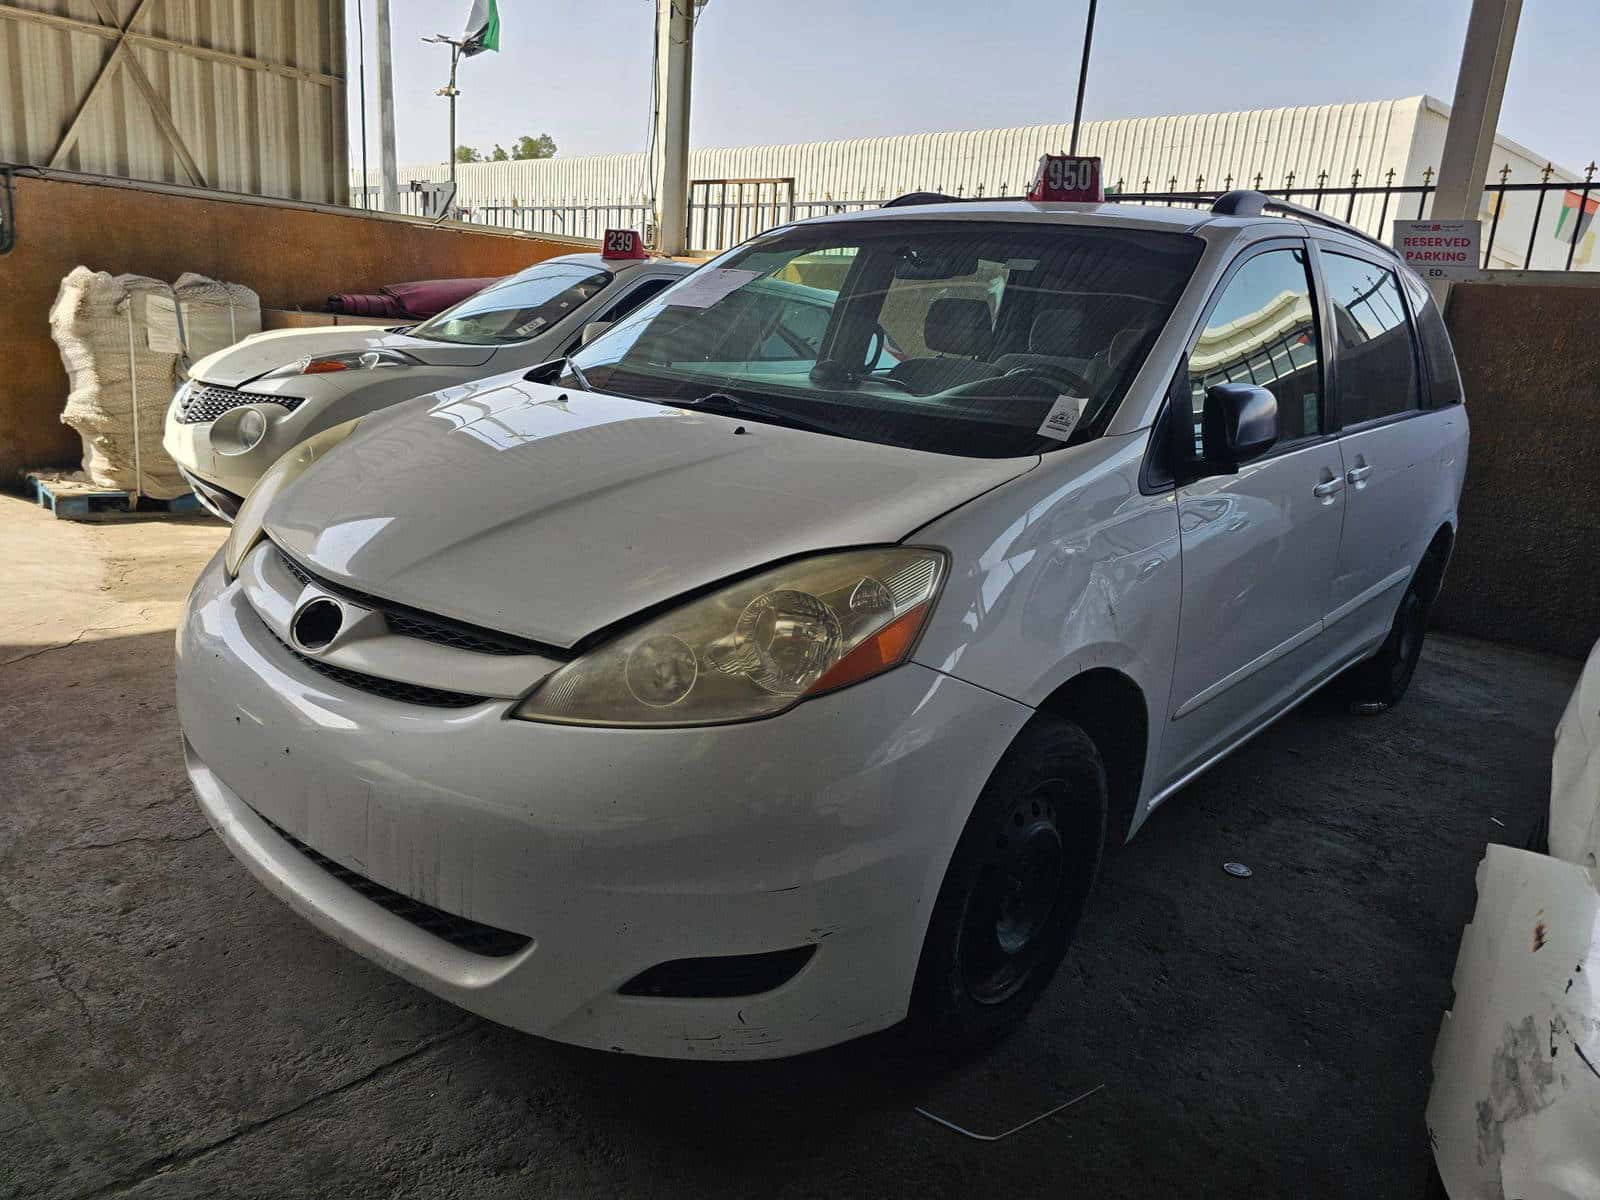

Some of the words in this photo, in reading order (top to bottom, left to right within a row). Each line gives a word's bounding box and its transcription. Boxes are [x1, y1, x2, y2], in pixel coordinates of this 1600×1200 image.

[1049, 160, 1092, 190] 950
[608, 232, 633, 251] 239
[1404, 237, 1471, 247] RESERVED
[1406, 252, 1467, 261] PARKING
